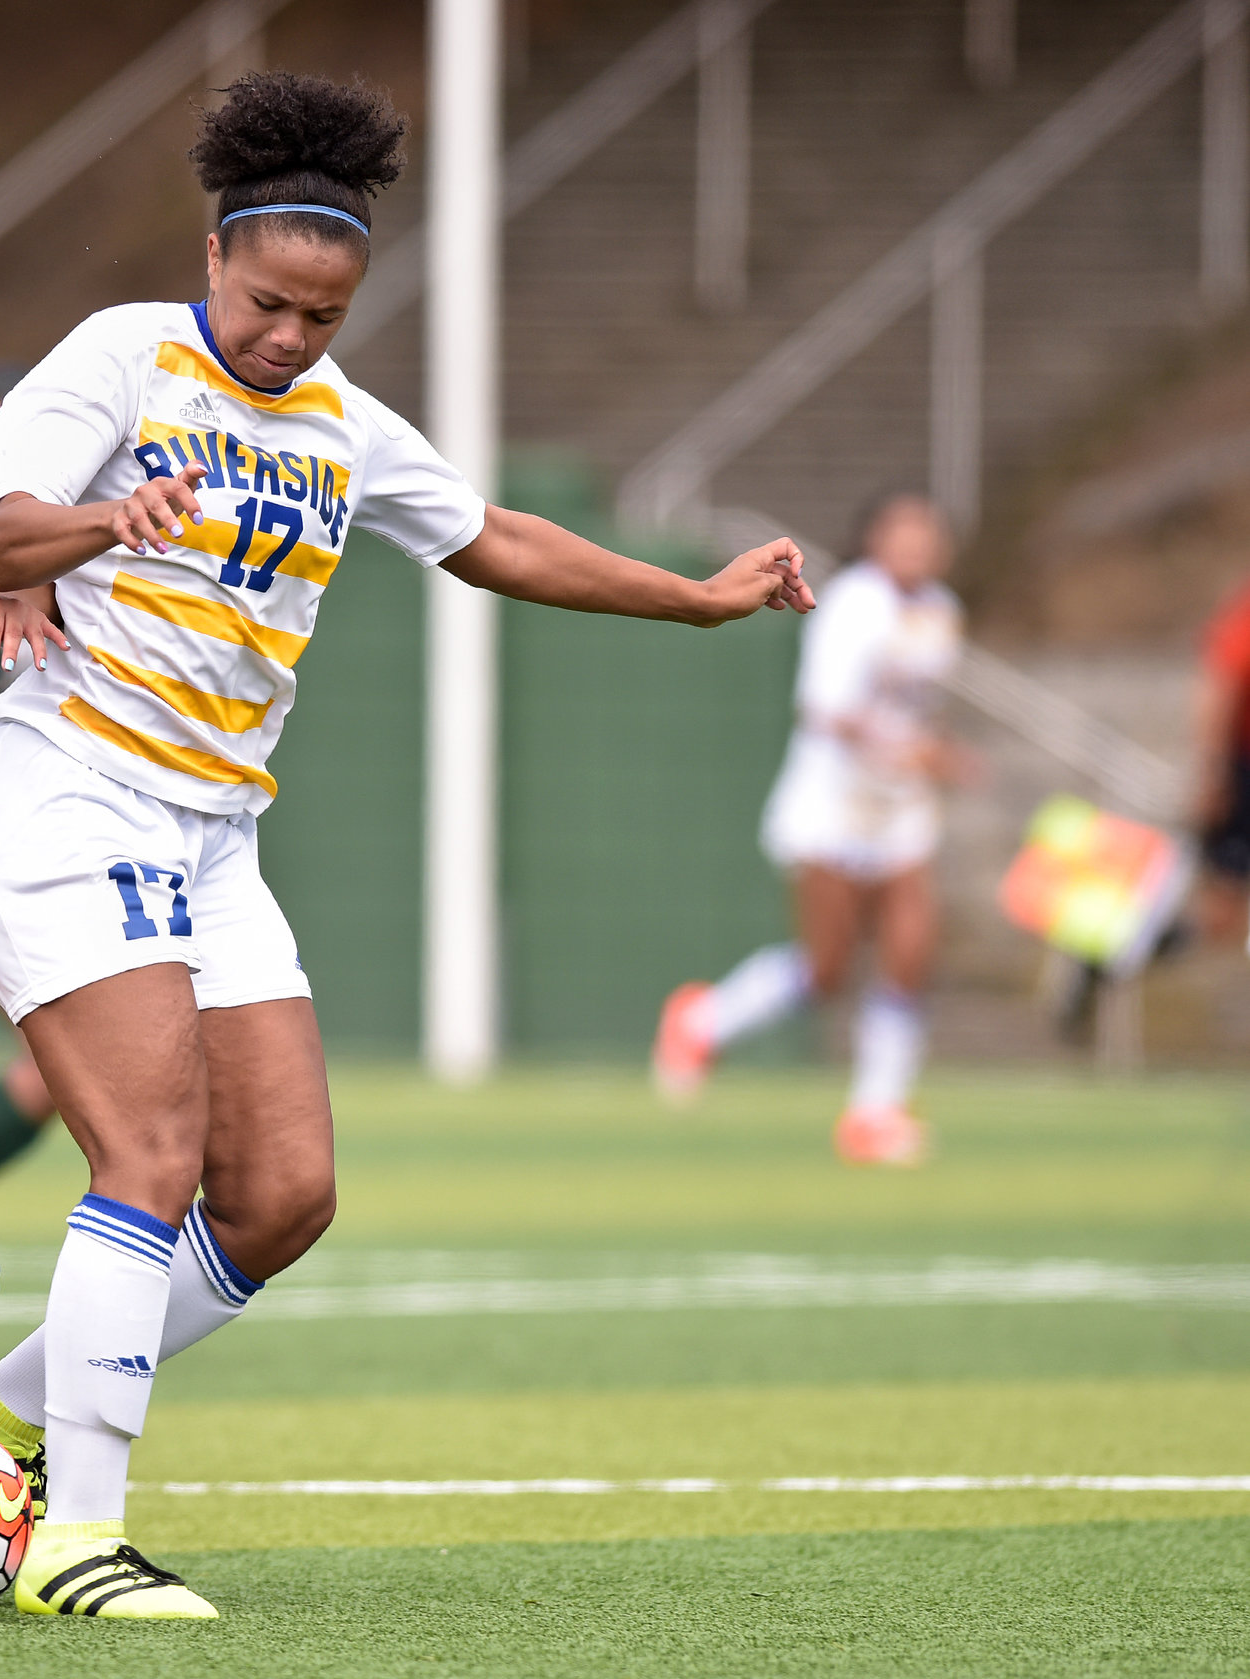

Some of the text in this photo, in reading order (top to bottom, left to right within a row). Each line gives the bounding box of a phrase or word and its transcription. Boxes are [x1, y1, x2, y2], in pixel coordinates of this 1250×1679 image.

[179, 407, 221, 424] adidas
[219, 497, 304, 593] 17
[108, 861, 192, 940] 17
